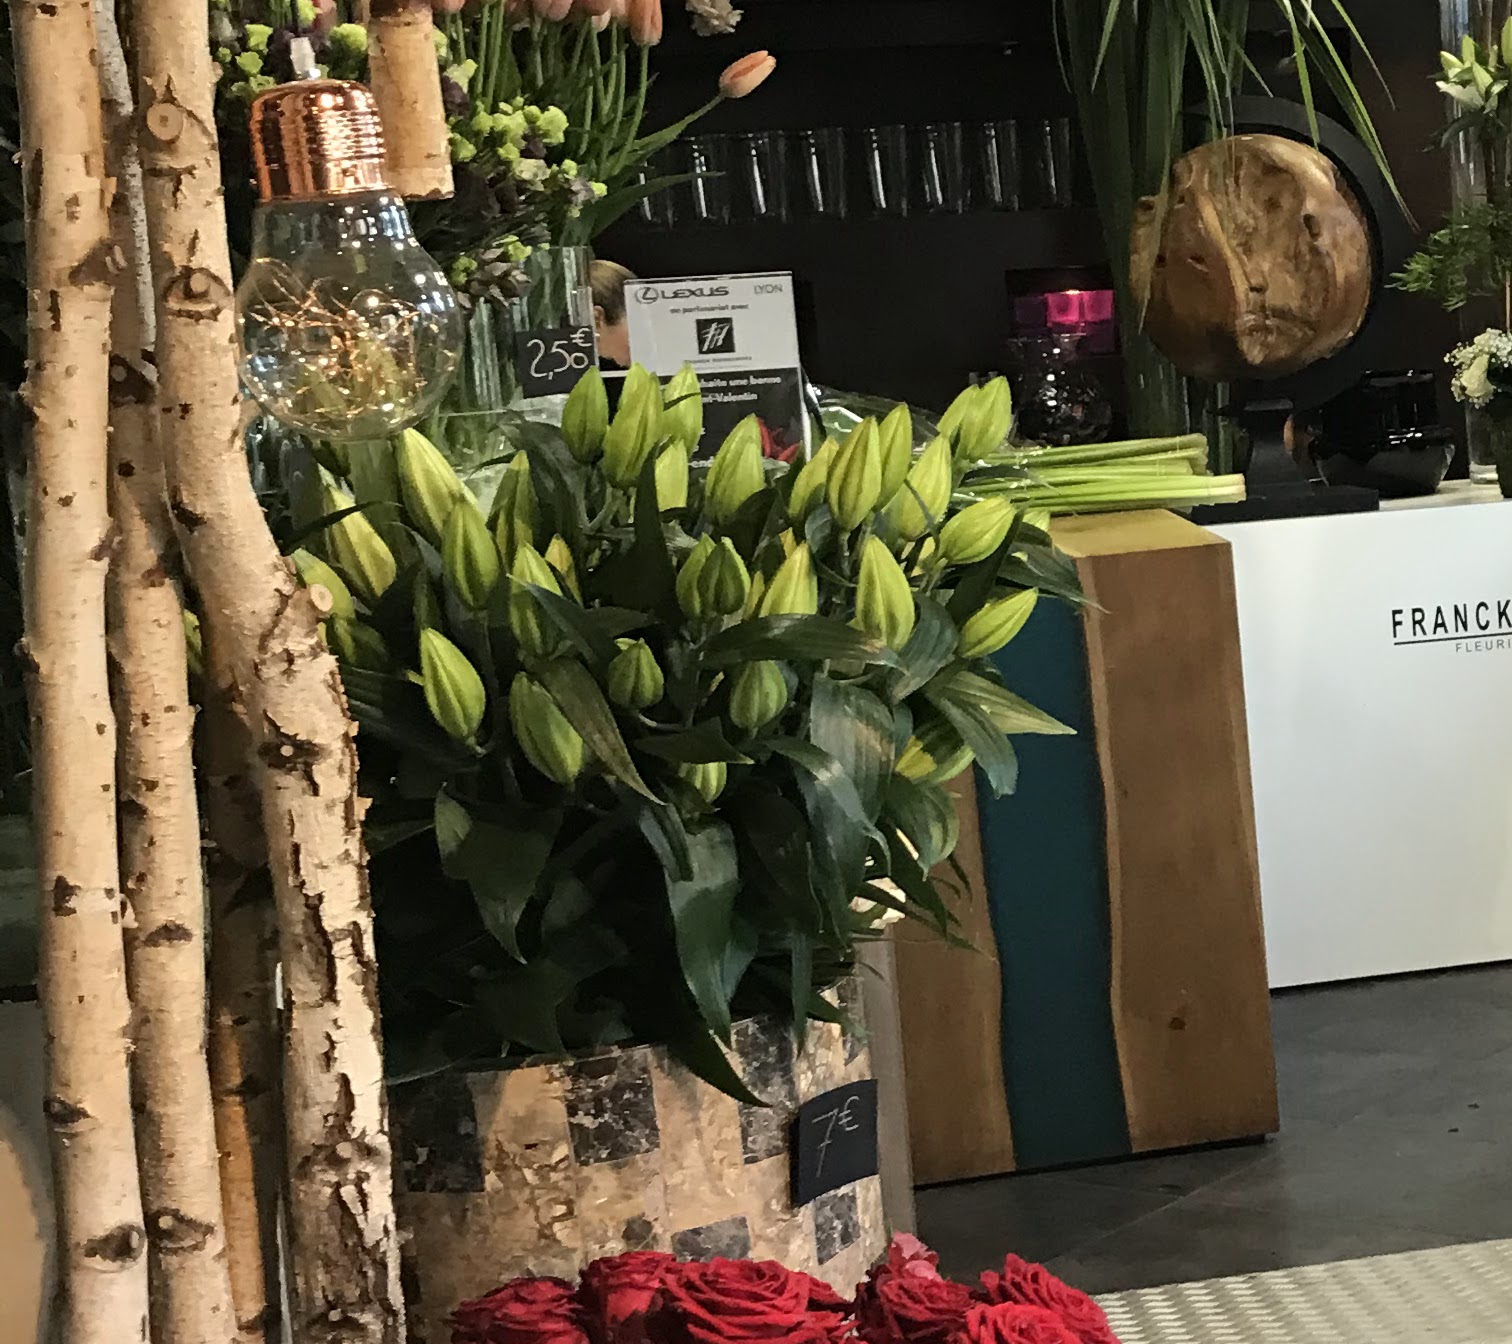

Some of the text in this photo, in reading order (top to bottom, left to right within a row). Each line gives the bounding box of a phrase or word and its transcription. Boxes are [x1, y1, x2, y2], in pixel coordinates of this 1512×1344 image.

[661, 284, 783, 299] LEXUS LYON
[1391, 599, 1512, 638] FRANCK
